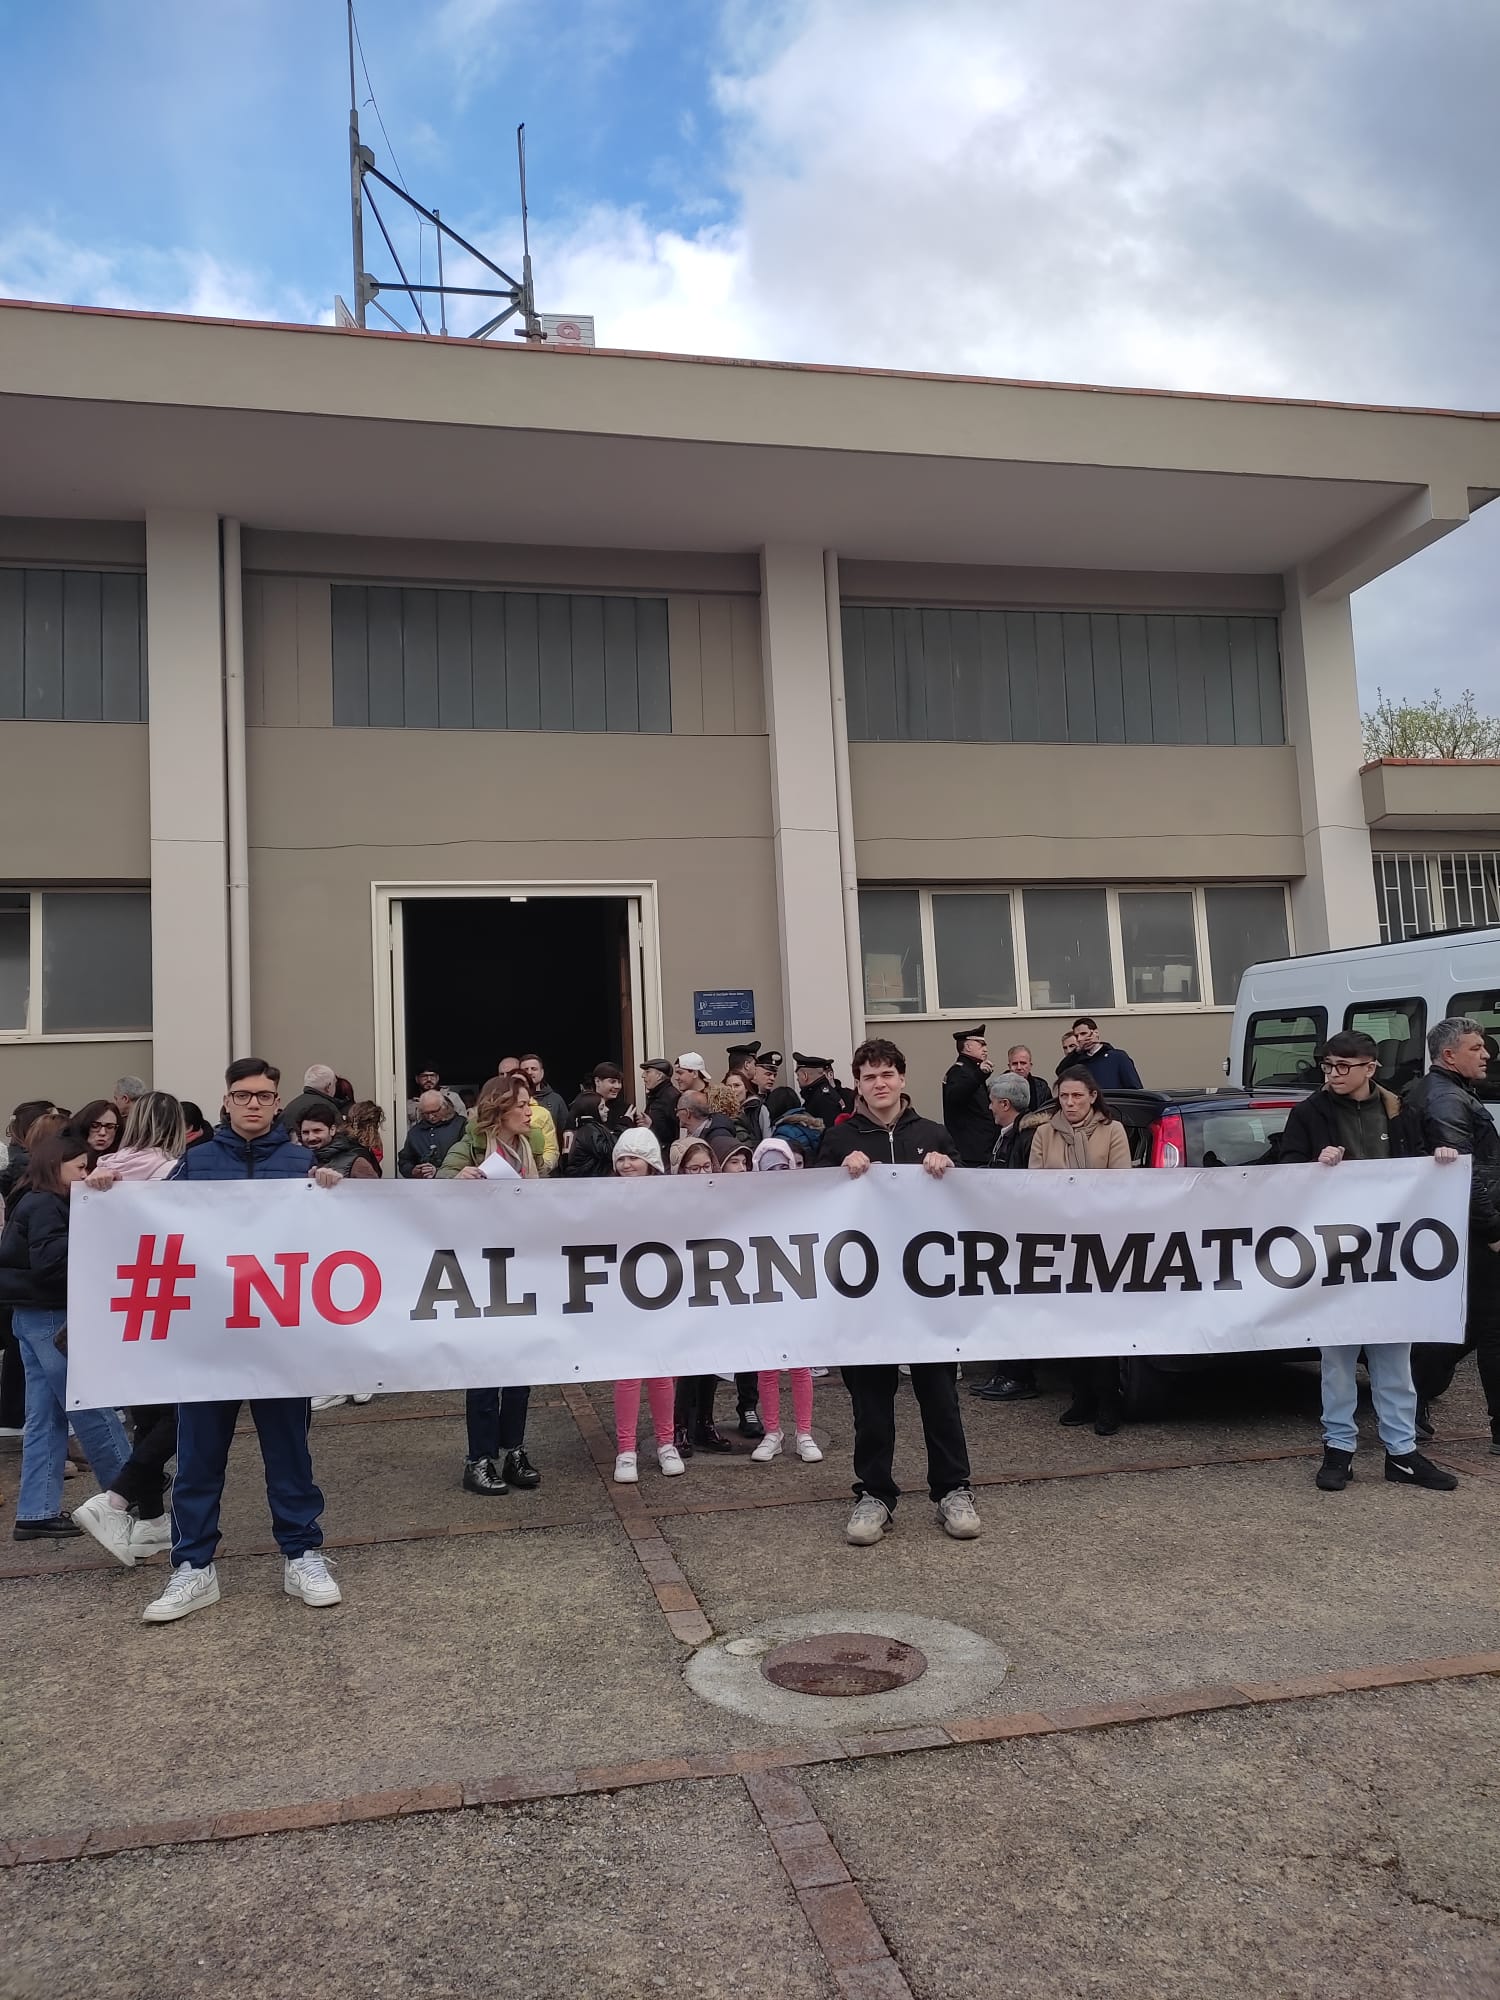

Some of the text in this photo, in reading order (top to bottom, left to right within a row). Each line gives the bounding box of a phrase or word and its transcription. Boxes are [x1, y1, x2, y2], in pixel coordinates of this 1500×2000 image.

[725, 1019, 753, 1027] QUARTIERE
[410, 1247, 537, 1321] AL
[561, 1229, 880, 1315] FORNO
[902, 1217, 1459, 1299] CREMATORIO
